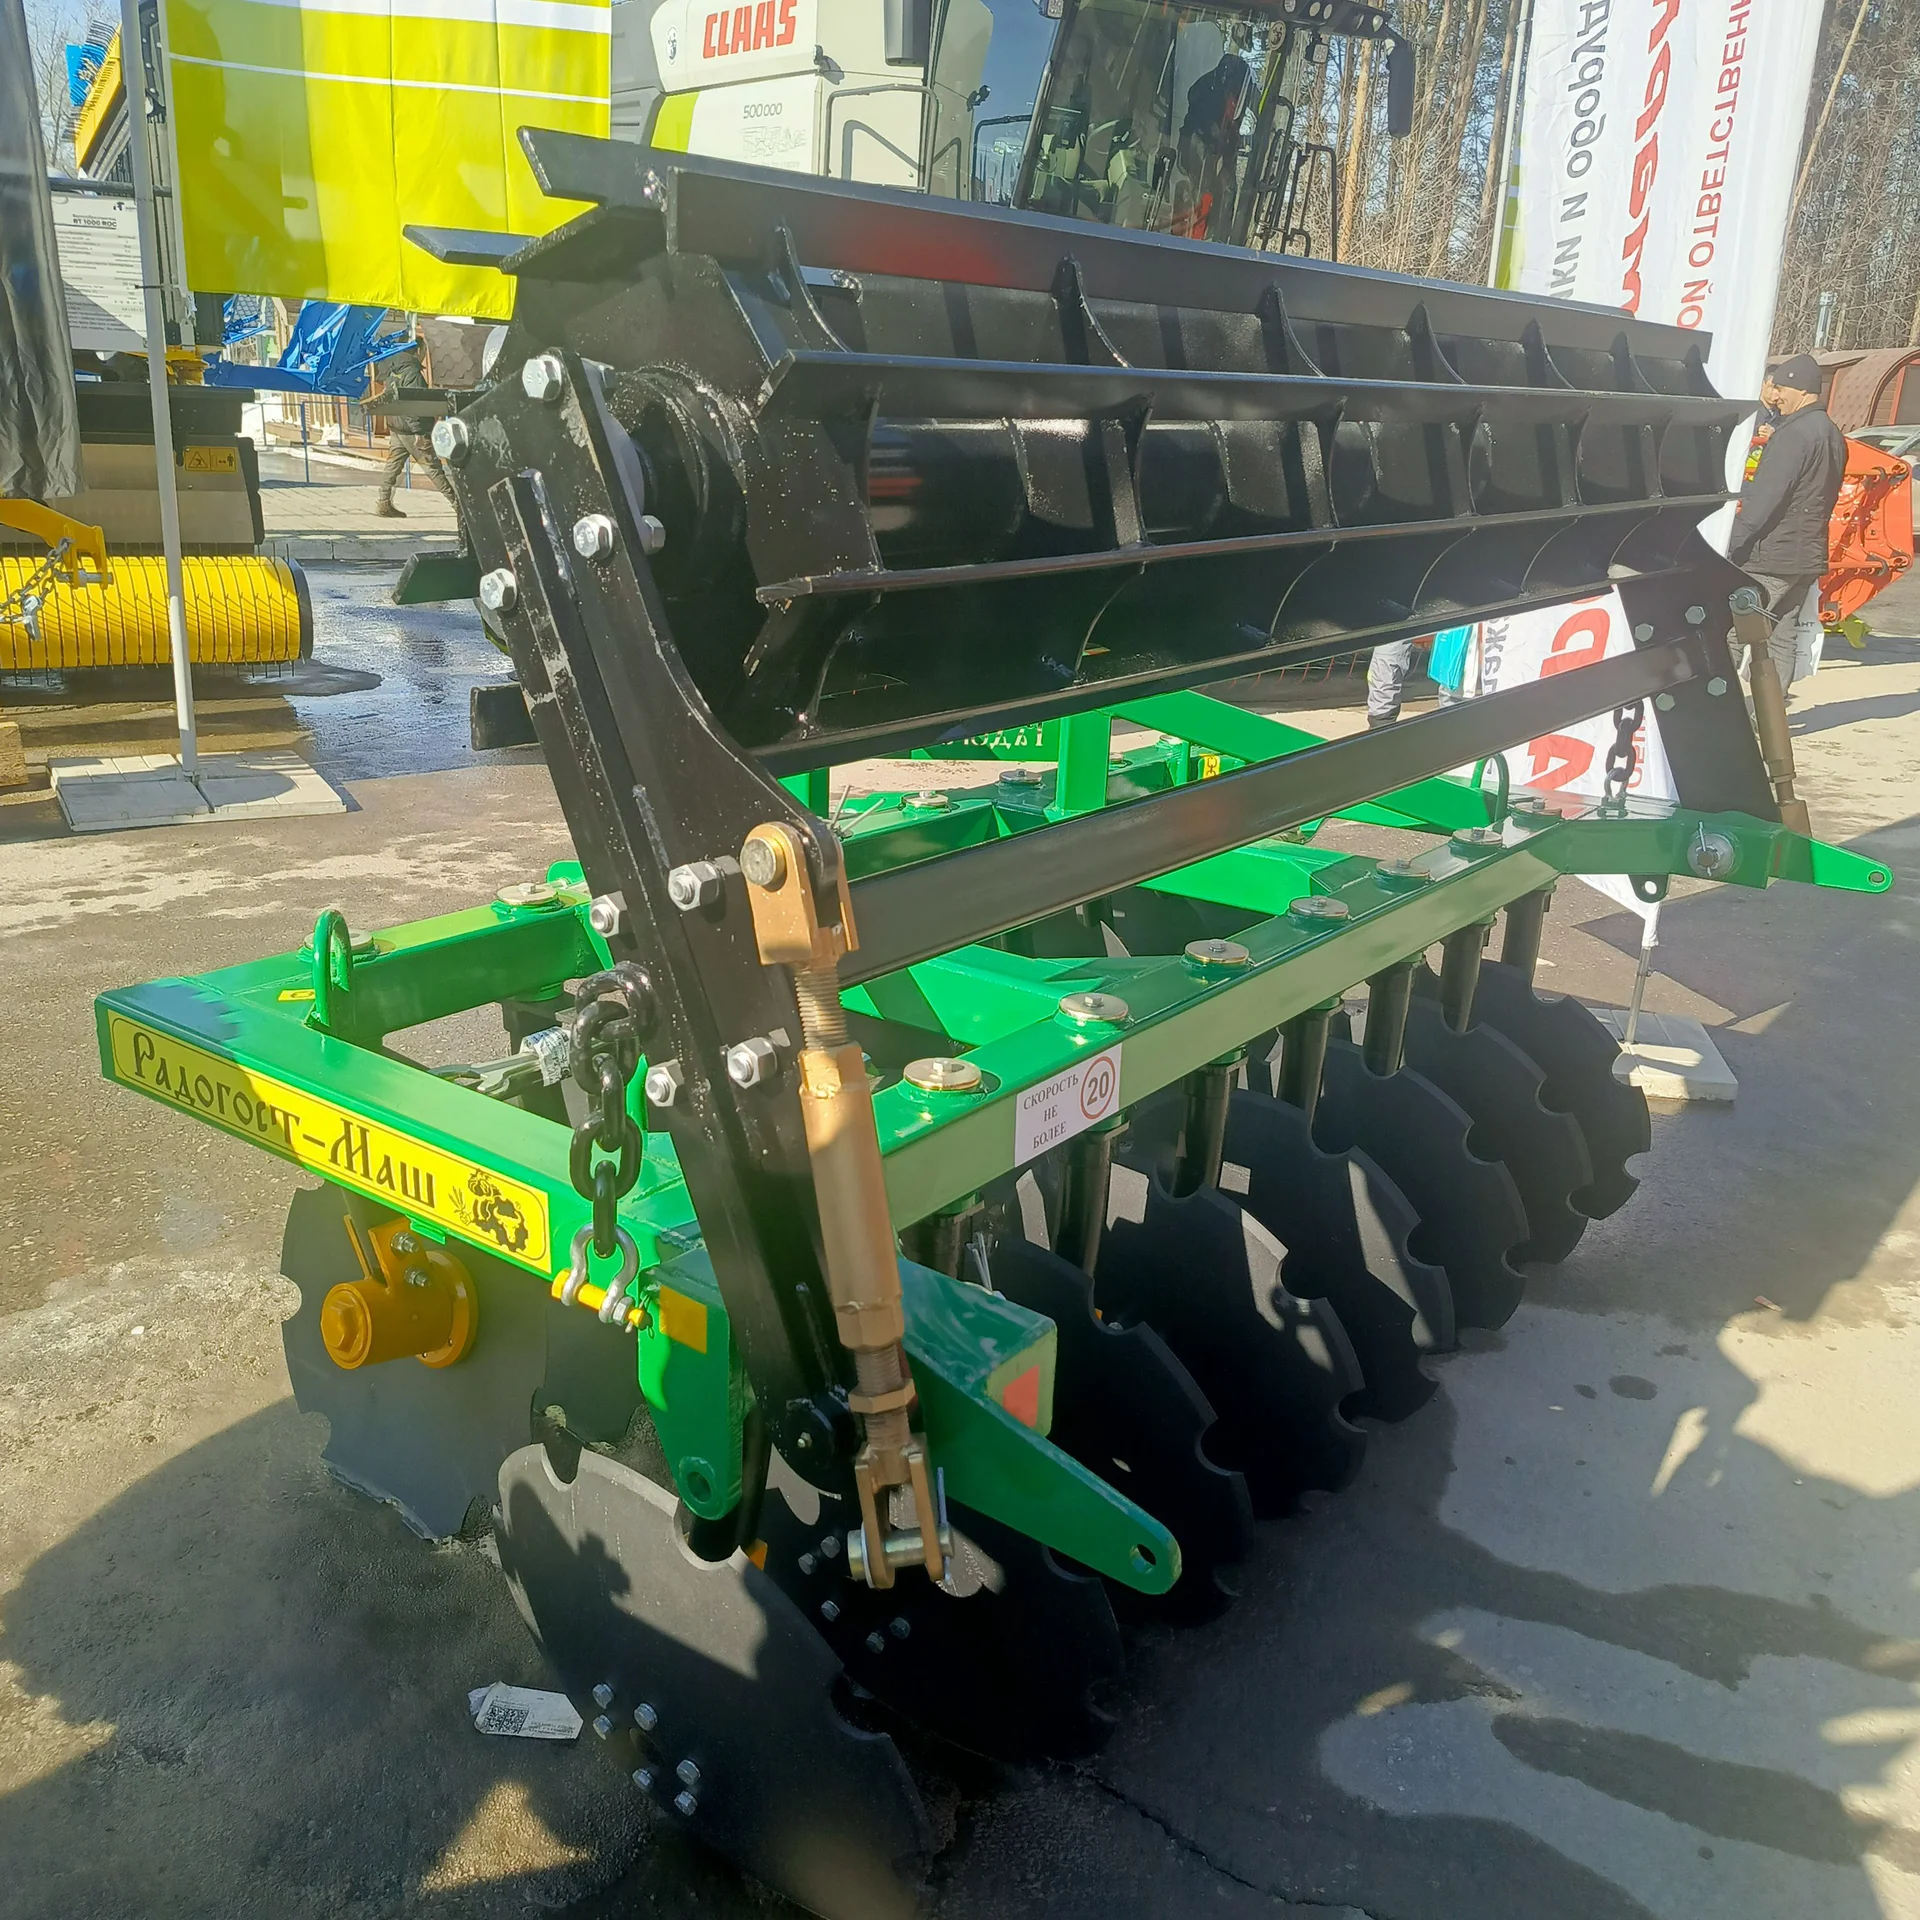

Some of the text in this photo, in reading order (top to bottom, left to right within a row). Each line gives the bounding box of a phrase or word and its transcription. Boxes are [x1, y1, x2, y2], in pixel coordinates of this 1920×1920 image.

[702, 0, 798, 59] CLAAS
[1023, 1073, 1079, 1110] СКОРОСТЬ
[1086, 1071, 1110, 1106] 20
[1044, 1104, 1058, 1122] НЕ
[1033, 1121, 1067, 1150] БОЛЕЕ
